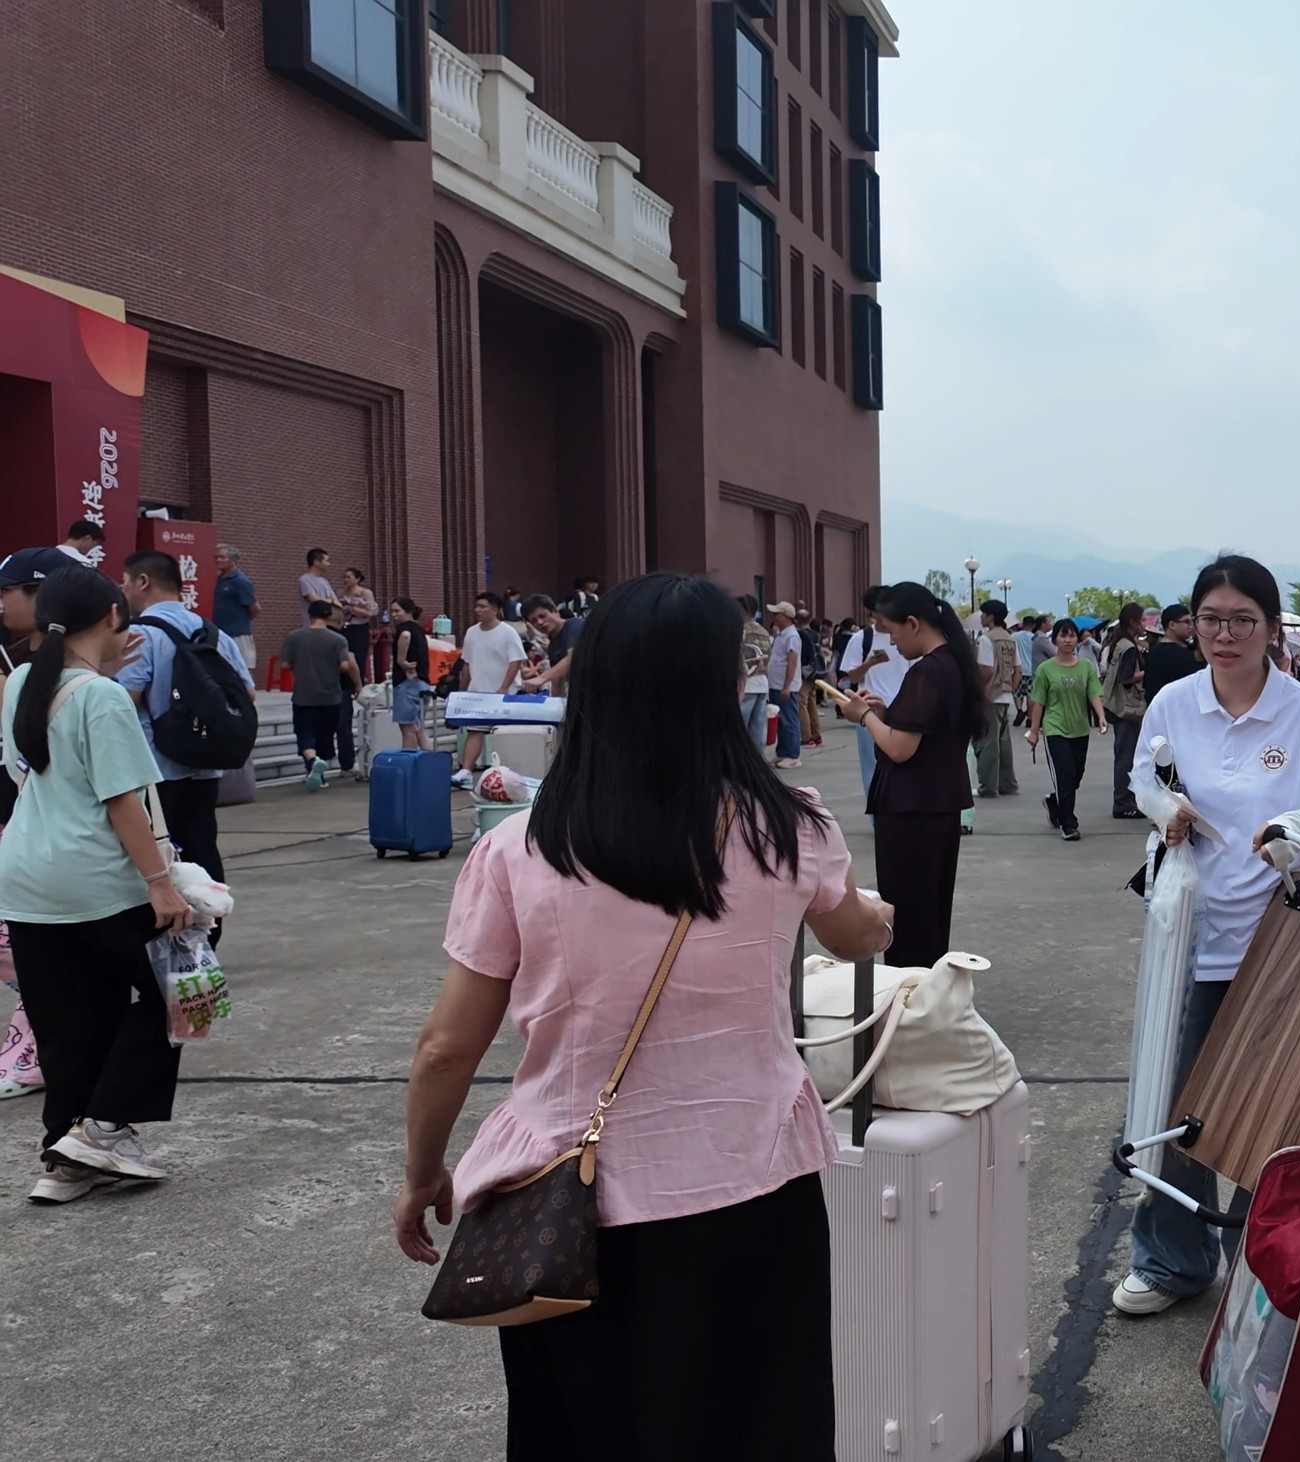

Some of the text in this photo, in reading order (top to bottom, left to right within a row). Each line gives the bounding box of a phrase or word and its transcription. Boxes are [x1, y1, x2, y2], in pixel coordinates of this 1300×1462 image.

[99, 427, 118, 489] 2026
[179, 554, 199, 610] 检录
[179, 993, 206, 1006] PACK
[182, 1001, 208, 1015] PACK
